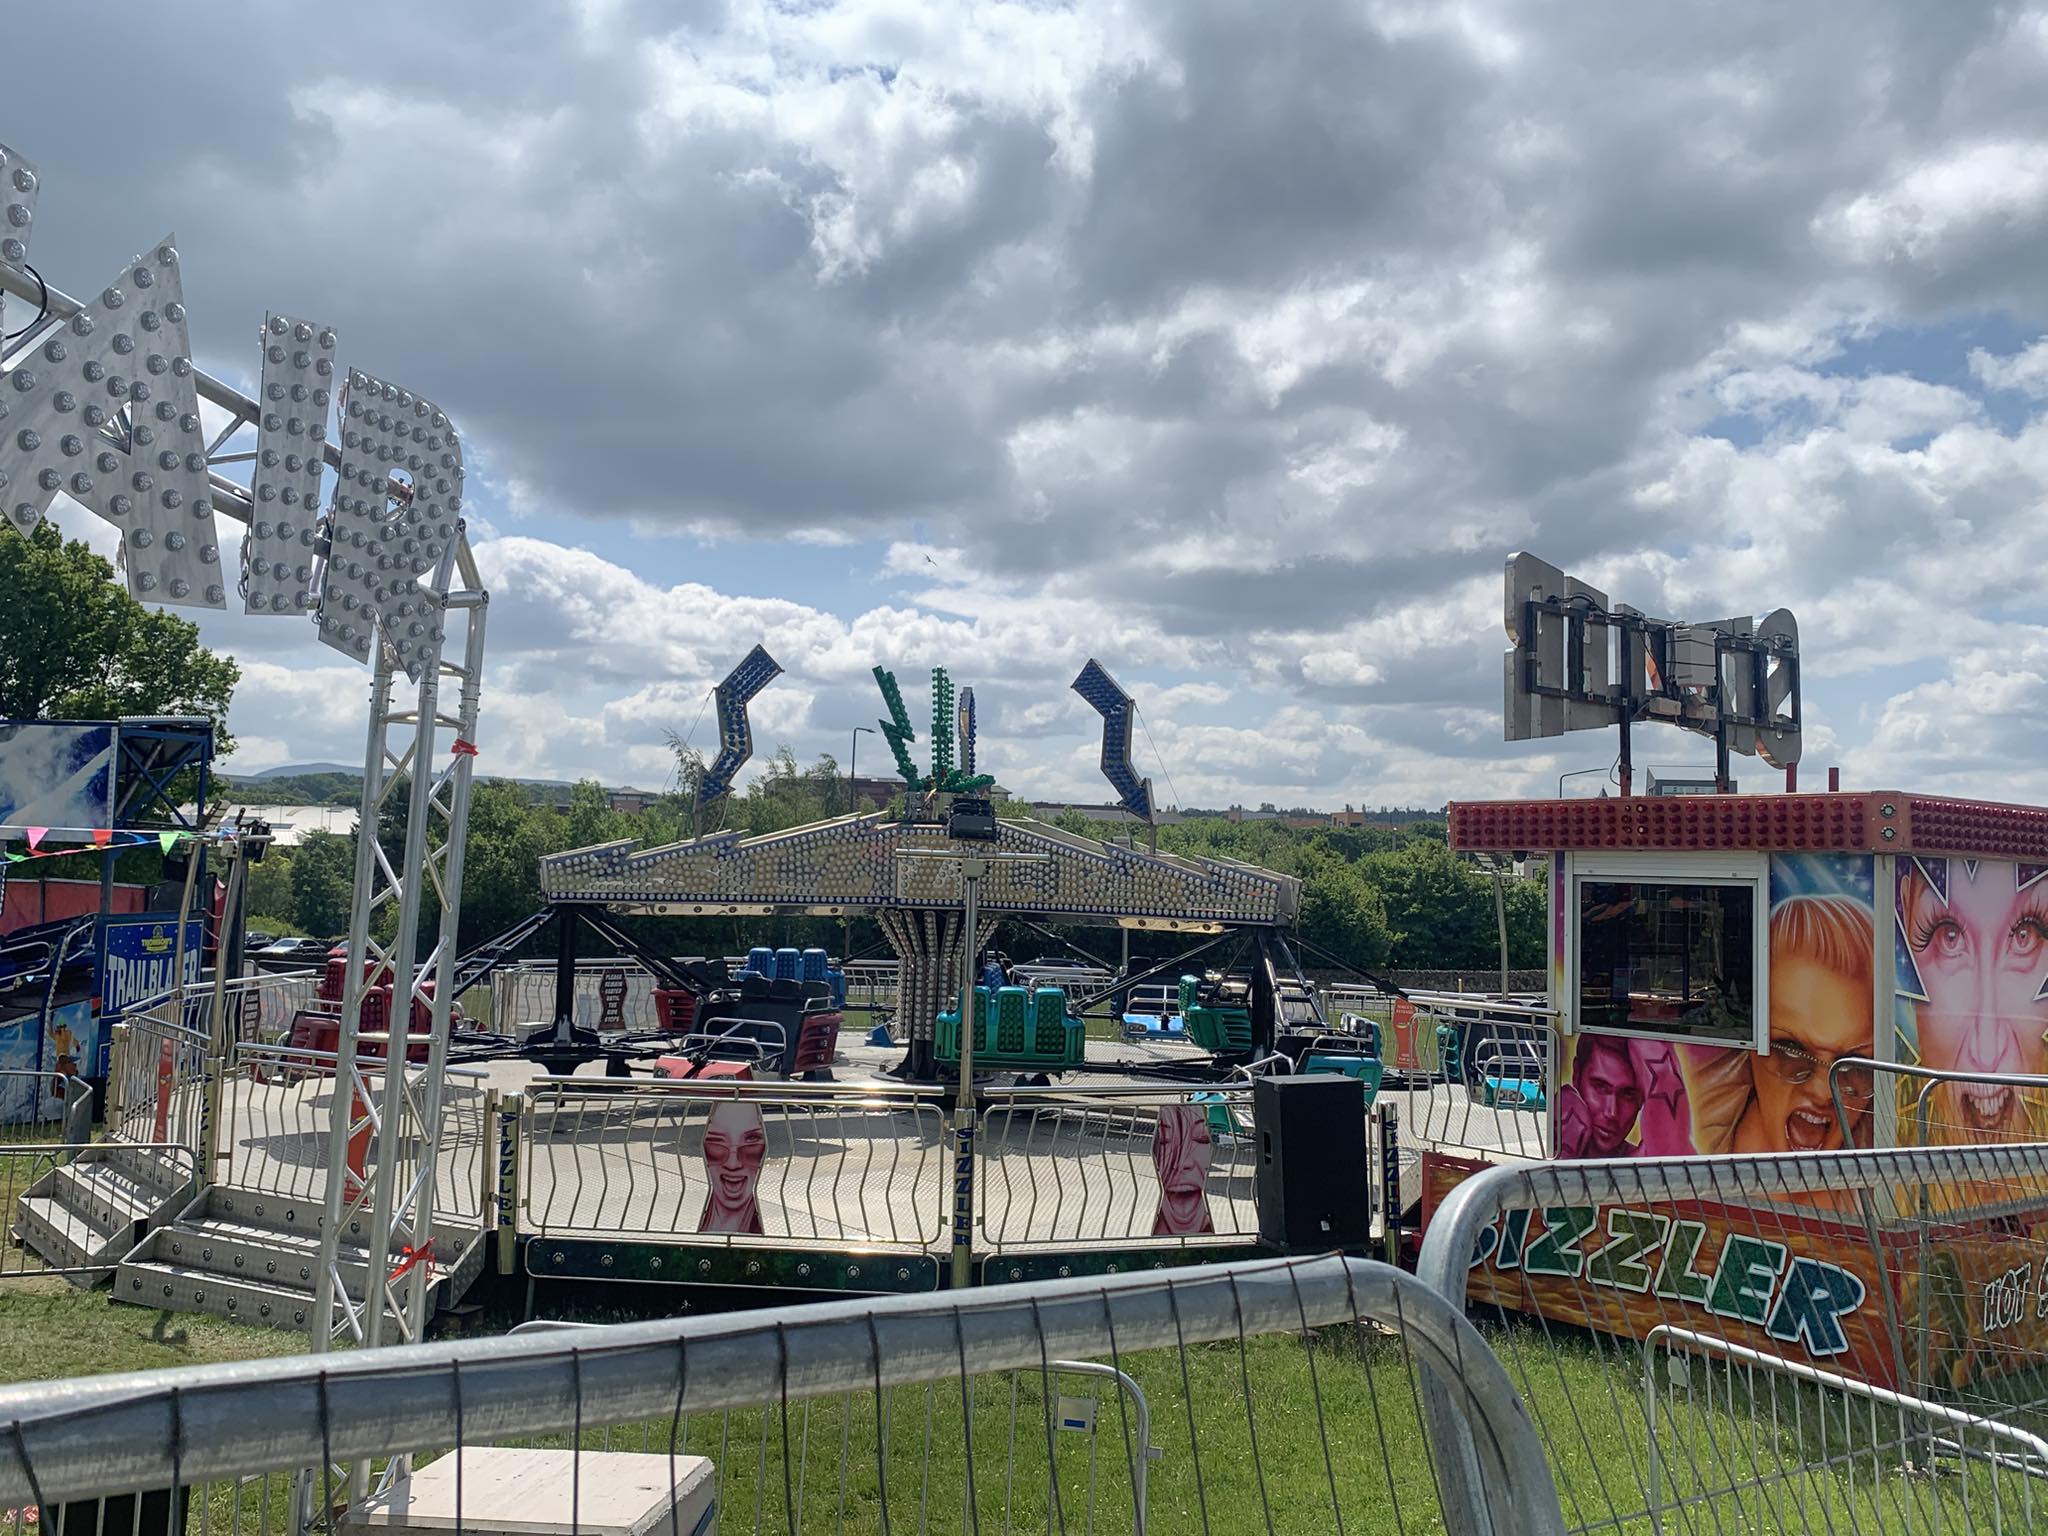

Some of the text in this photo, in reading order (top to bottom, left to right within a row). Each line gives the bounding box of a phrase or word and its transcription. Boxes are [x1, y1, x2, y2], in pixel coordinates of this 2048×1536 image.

[107, 949, 198, 1011] TRAILBLAER
[498, 1111, 518, 1226] SIZZLER
[953, 1127, 975, 1246] SIZZLER
[1983, 1262, 2031, 1332] HOT
